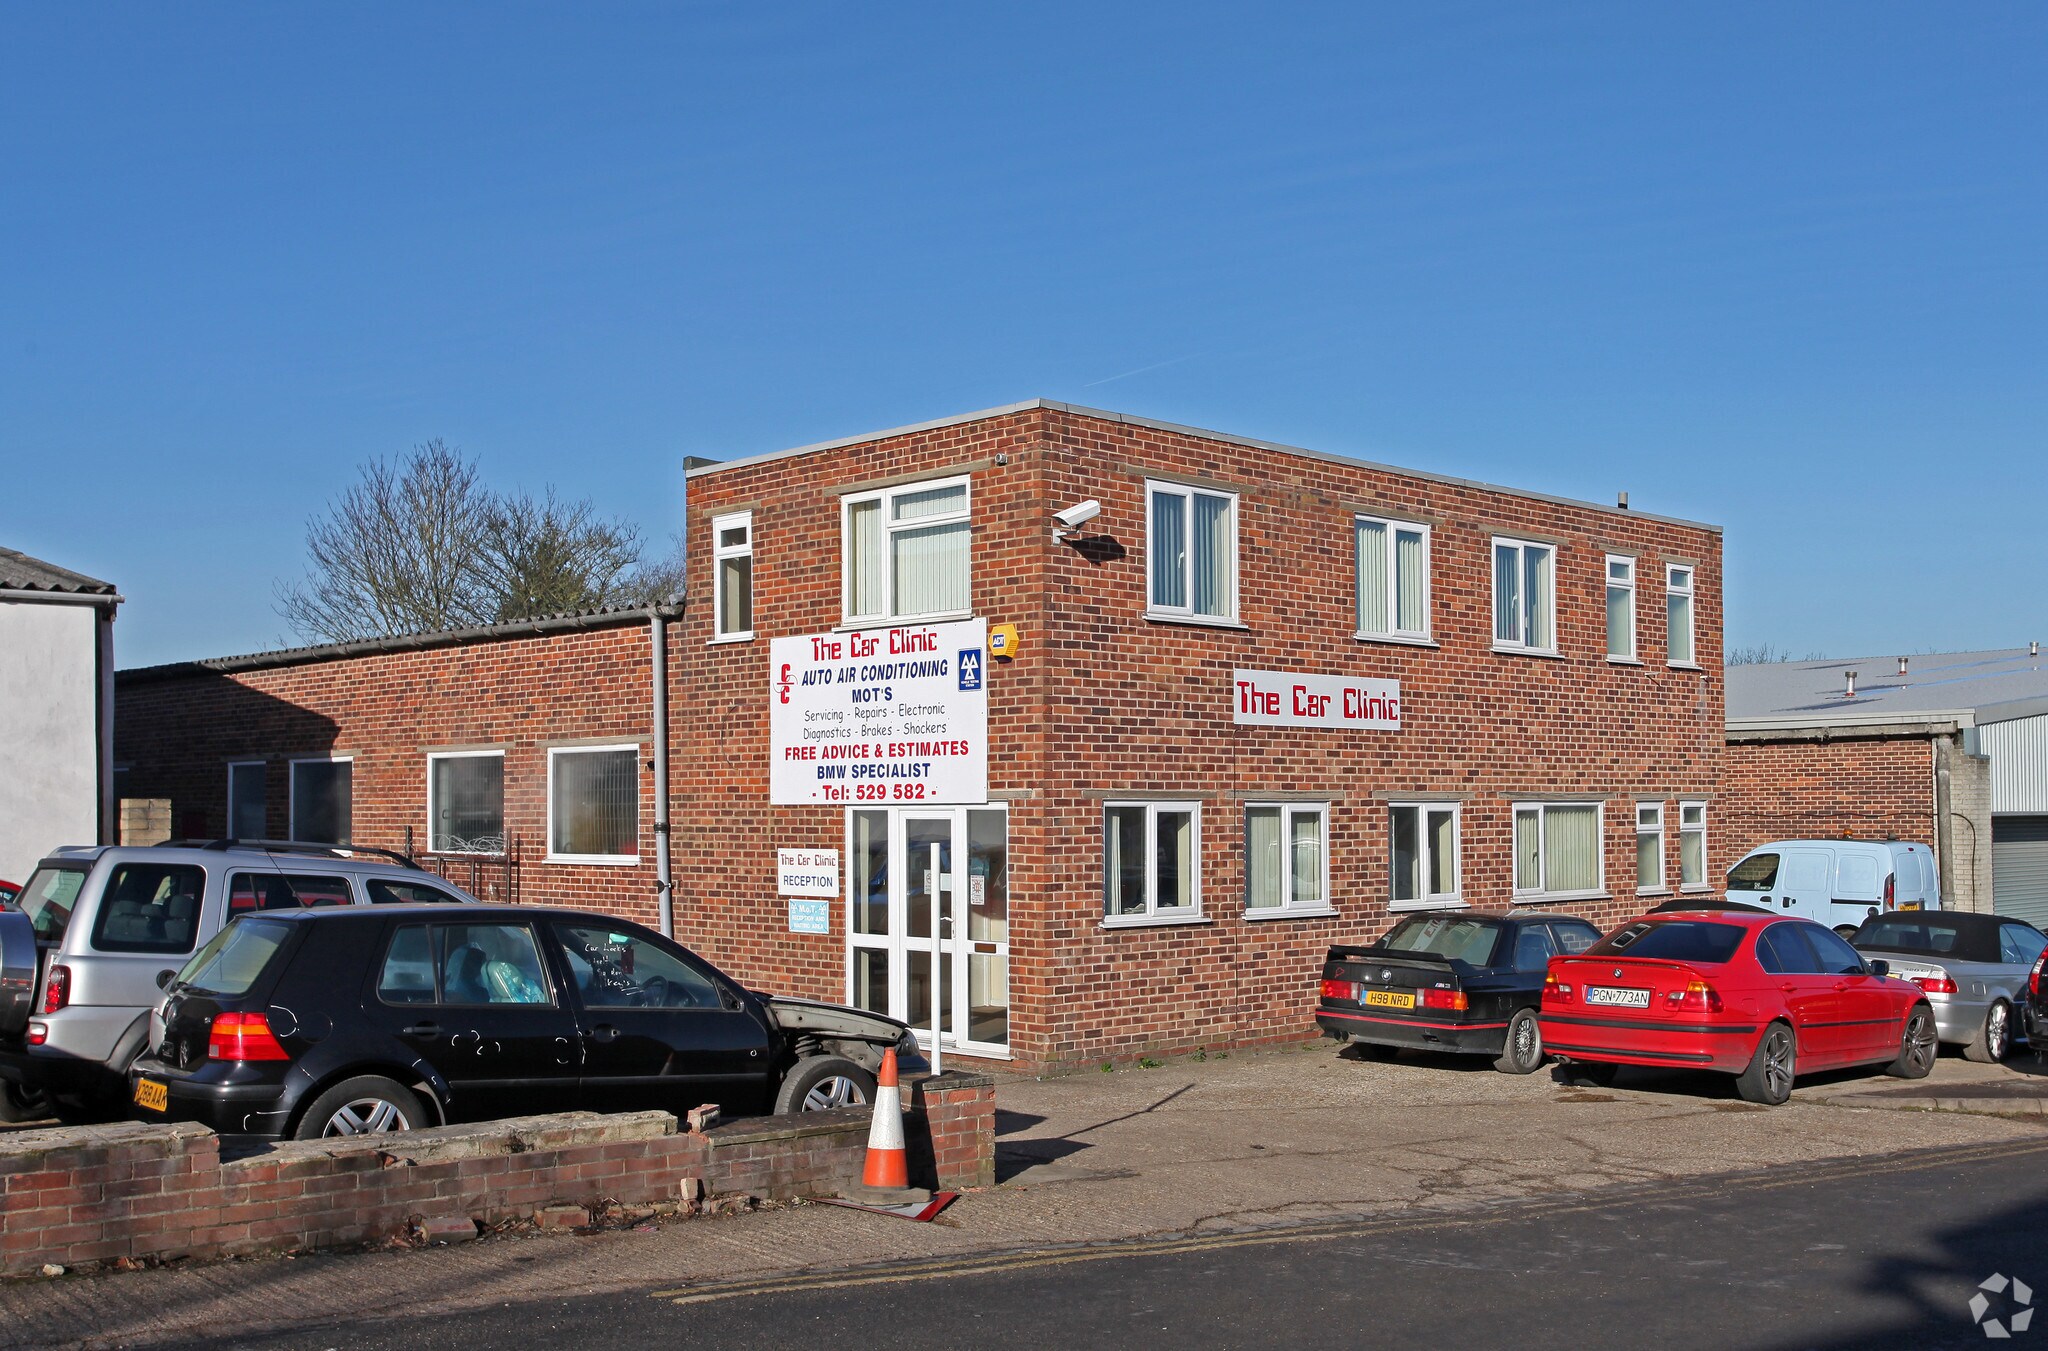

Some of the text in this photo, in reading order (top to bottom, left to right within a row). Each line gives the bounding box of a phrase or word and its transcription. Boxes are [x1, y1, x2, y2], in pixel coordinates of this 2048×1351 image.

[811, 628, 937, 661] The Car Clinic
[802, 659, 948, 686] AUTO AIR CONDITIONING
[852, 686, 893, 703] MOT'S
[1237, 681, 1398, 721] The Car Clinic
[804, 710, 843, 723] Servicing
[854, 705, 887, 722] Repairs
[898, 702, 945, 716] Electronic
[803, 726, 851, 742] Diagnostics
[861, 724, 892, 737] Brakes
[903, 721, 947, 735] Shockers
[785, 740, 969, 761] FREE ADVICE & ESTIMATES
[817, 763, 931, 780] BMW SPECIALIST
[823, 785, 850, 800] Tel:
[856, 784, 887, 800] 529
[893, 783, 925, 799] 582
[780, 854, 836, 867] The Car Clinic
[783, 875, 833, 887] RECEPTION
[1370, 993, 1410, 1006] H98 NRD
